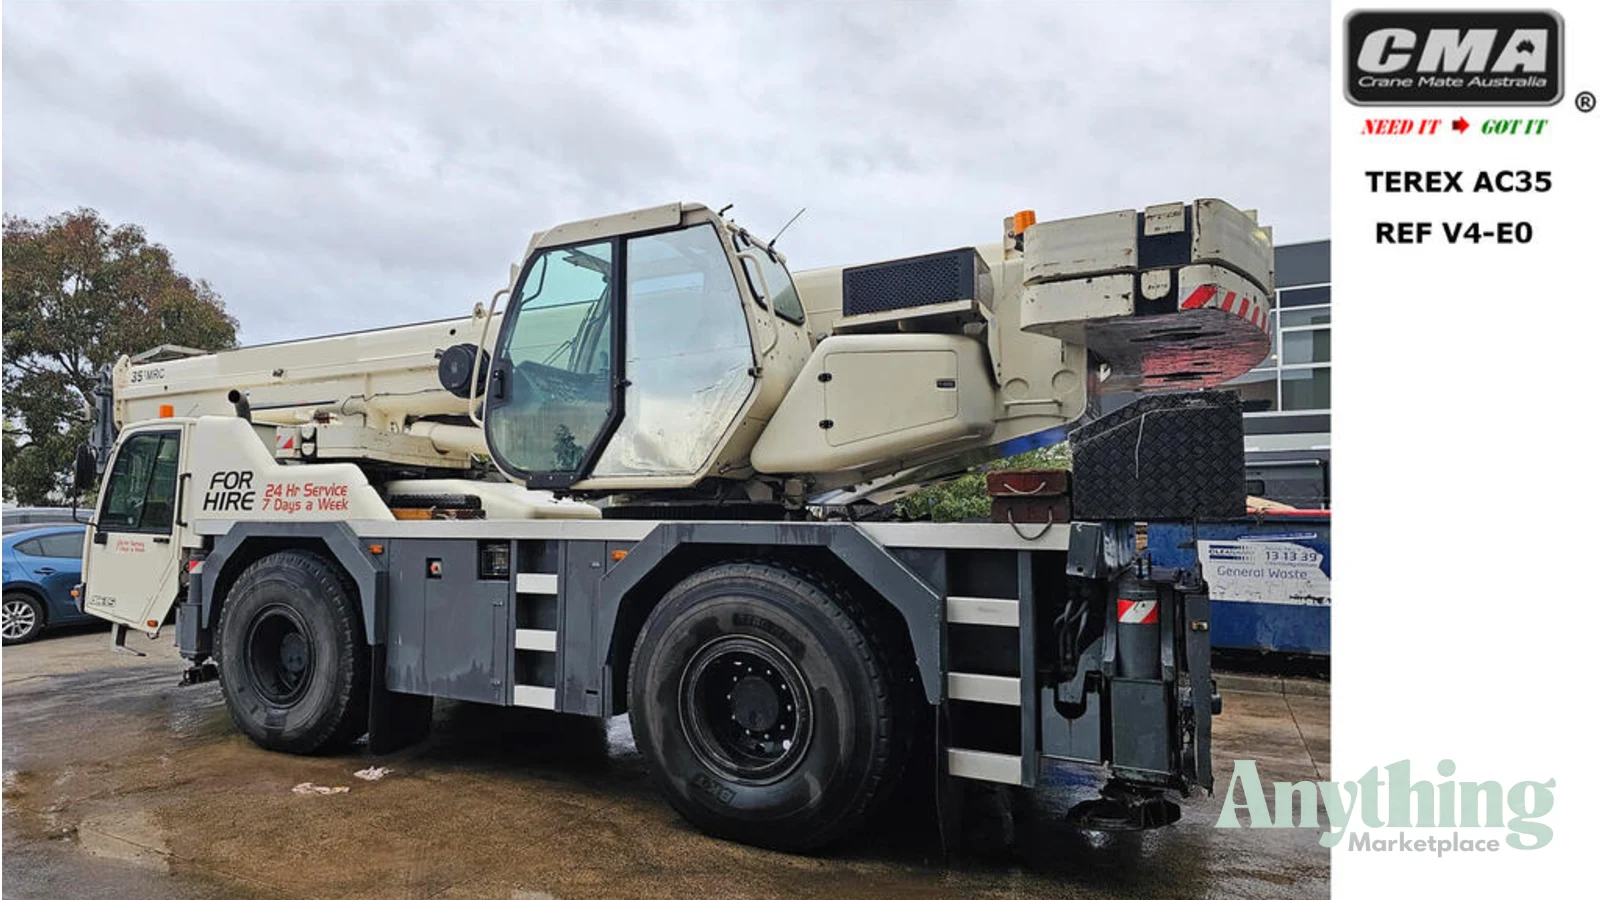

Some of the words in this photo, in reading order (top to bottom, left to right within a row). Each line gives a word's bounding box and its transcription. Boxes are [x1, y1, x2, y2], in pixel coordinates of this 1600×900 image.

[209, 471, 254, 490] FOR
[265, 484, 282, 497] 24
[286, 484, 300, 497] Hr
[303, 483, 348, 497] Service
[203, 491, 256, 511] HIRE
[262, 498, 270, 511] 7
[273, 498, 301, 514] Days
[305, 501, 313, 511] a
[318, 498, 349, 511] Week
[1265, 551, 1279, 561] 13
[1301, 552, 1317, 562] 39
[1217, 565, 1264, 578] General
[1268, 568, 1308, 580] Waste
